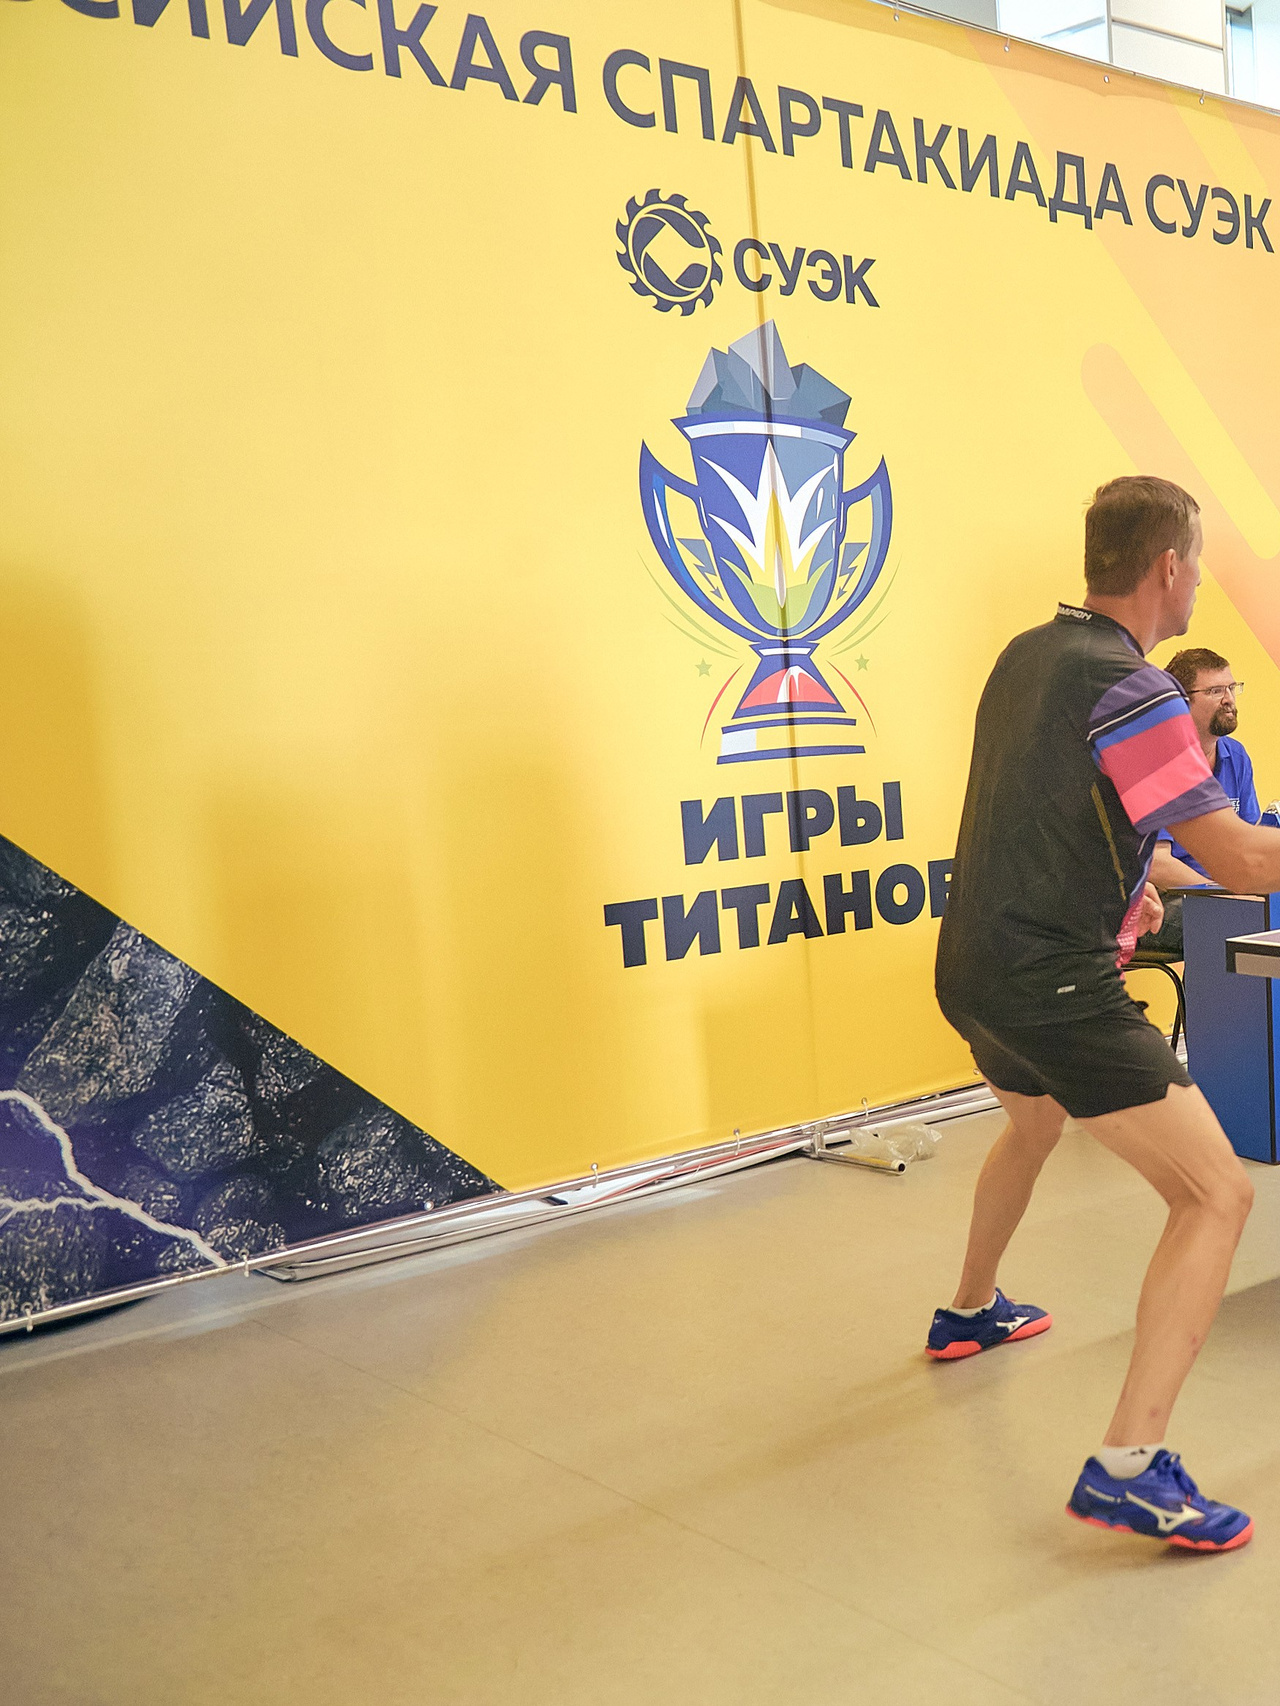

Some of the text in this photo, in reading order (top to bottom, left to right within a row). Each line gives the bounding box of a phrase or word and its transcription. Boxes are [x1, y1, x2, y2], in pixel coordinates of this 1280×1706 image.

[602, 48, 1133, 231] СПАРТАКИАДА
[1144, 174, 1274, 253] СУЭК
[732, 237, 881, 308] СУЭК
[680, 781, 905, 866] ИГРЫ
